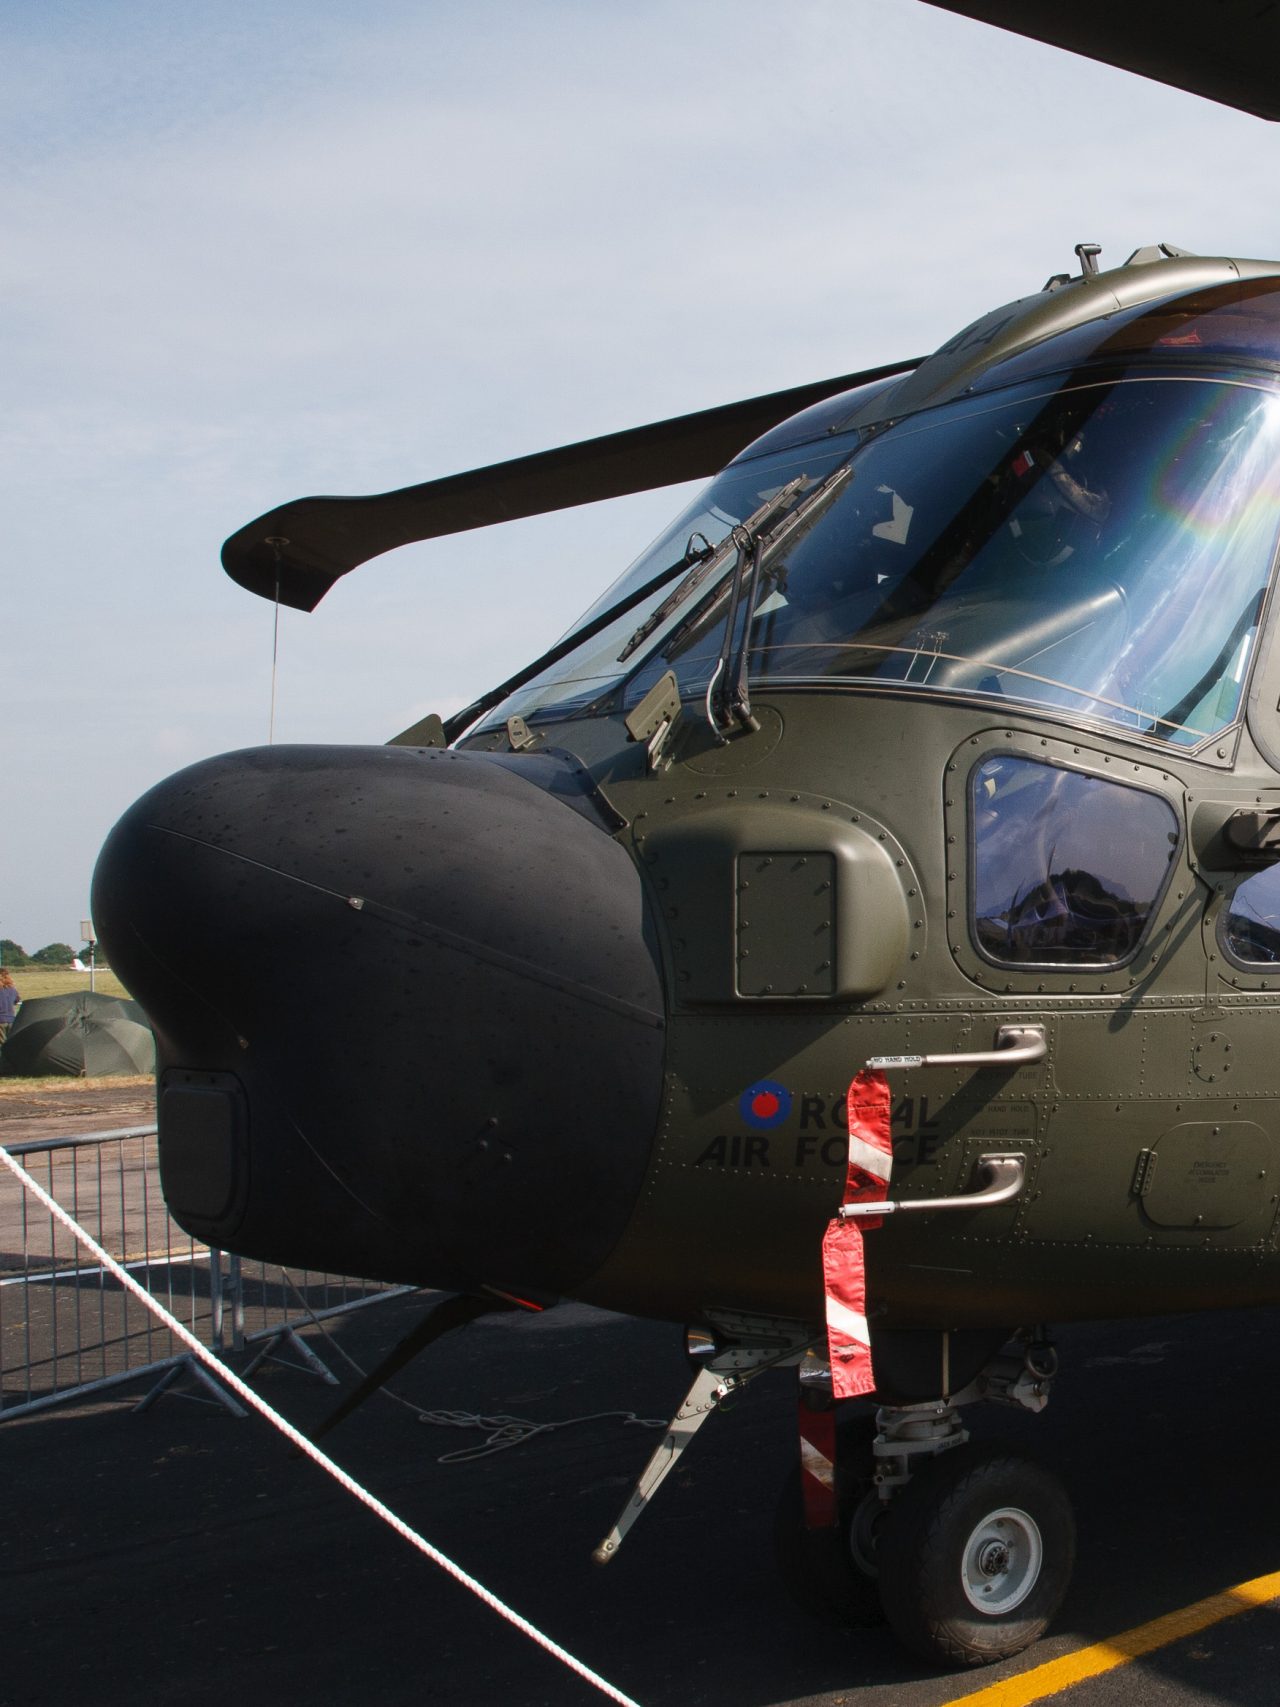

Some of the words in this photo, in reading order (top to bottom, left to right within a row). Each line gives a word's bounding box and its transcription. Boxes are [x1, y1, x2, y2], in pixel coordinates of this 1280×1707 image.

[800, 1095, 939, 1129] ROAL
[694, 1136, 770, 1167] AIR
[796, 1135, 939, 1167] FOCE
